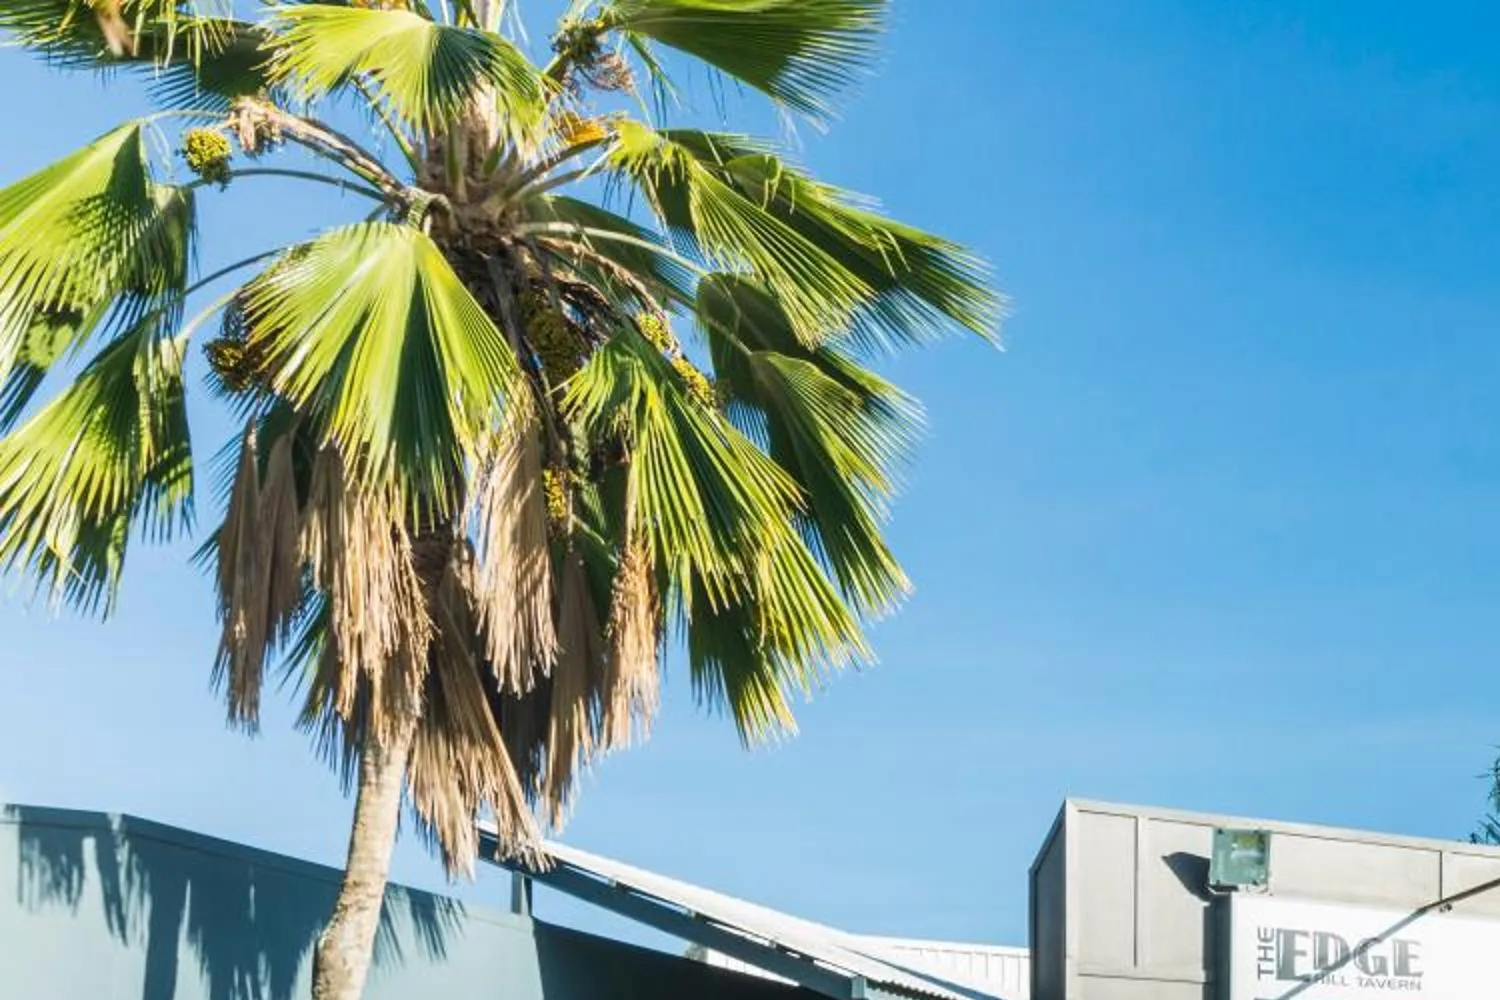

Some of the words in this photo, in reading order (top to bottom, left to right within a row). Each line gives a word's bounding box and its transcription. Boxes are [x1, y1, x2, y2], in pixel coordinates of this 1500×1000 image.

[1257, 927, 1274, 980] THE
[1276, 928, 1424, 980] EDGE
[1356, 976, 1422, 991] TAVERN
